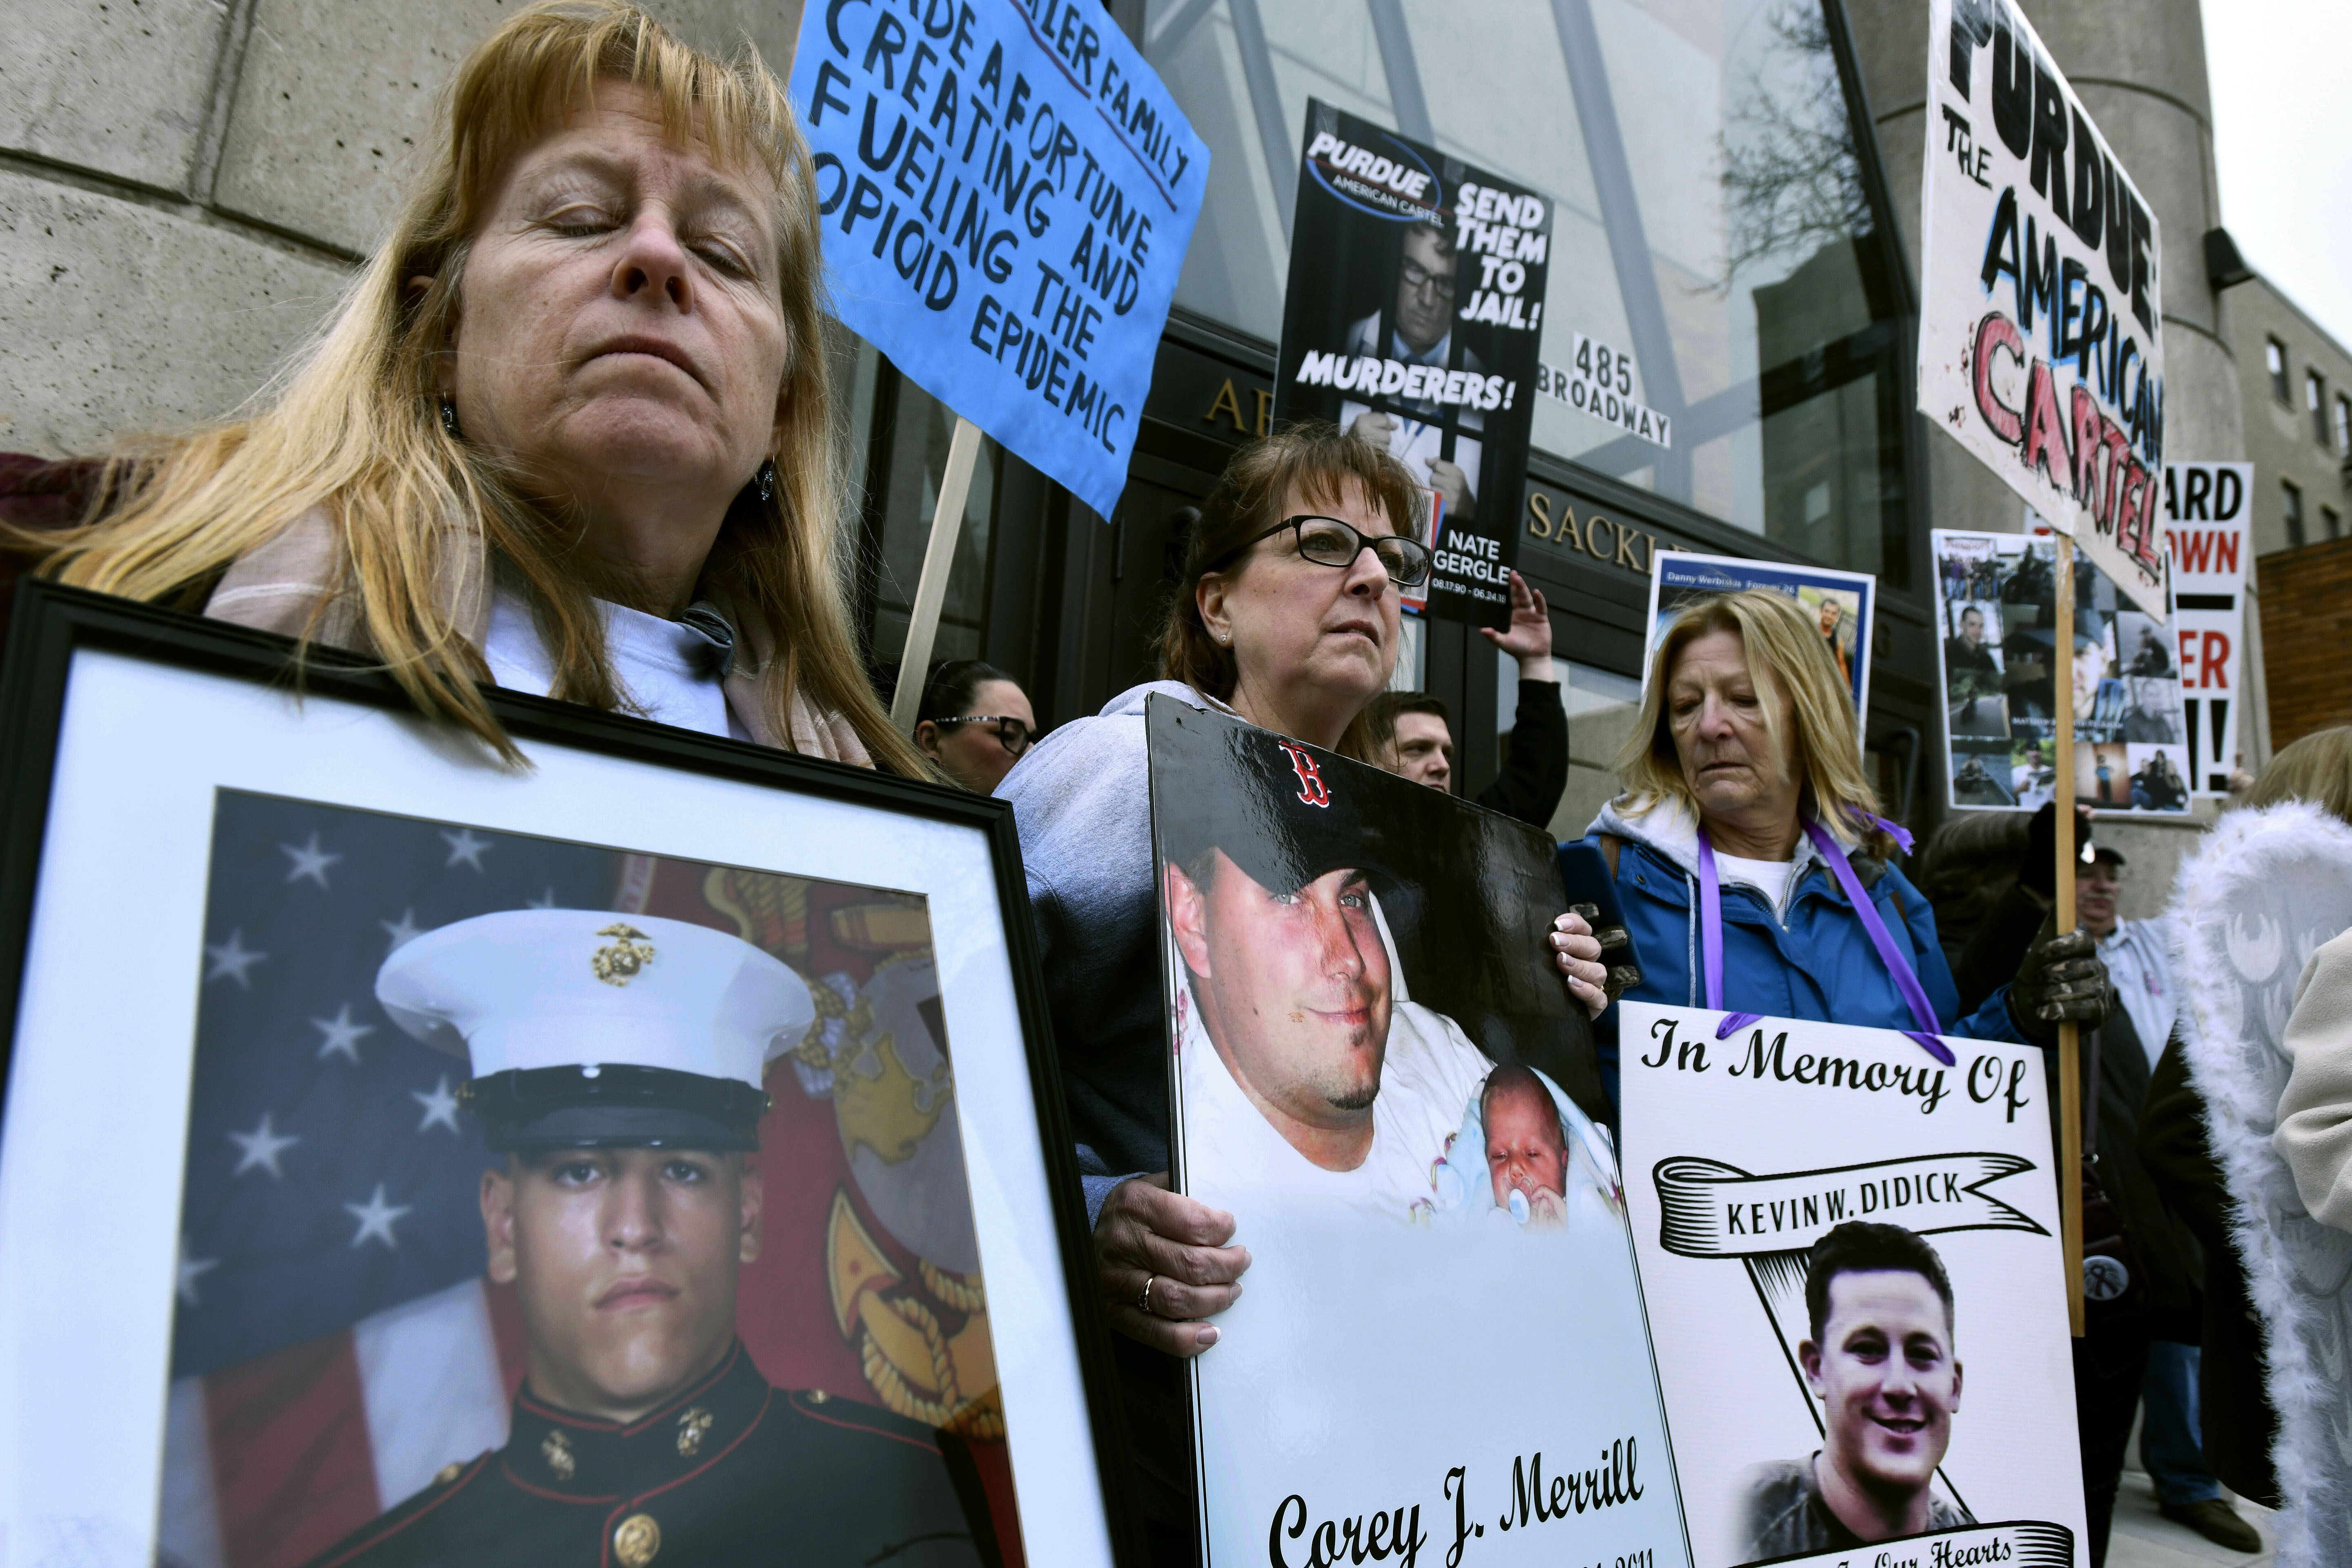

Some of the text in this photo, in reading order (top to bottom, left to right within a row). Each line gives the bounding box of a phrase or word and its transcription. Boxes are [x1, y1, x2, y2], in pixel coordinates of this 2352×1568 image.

[1026, 0, 1189, 189] LER FAMILY
[825, 0, 1139, 316] CREATING AND
[978, 38, 1003, 107] A
[1004, 72, 1152, 268] FORTUNE
[1307, 130, 1431, 200] PURDUE
[1941, 103, 1993, 190] THE
[808, 59, 1102, 361] FUELING THE
[1332, 174, 1444, 229] AMERICAN CARTEL
[1454, 182, 1545, 230] SEND
[1455, 215, 1548, 265] THEM
[813, 151, 1125, 454] OPIOID EPIDEMIC
[1480, 255, 1526, 294] TO
[1459, 289, 1542, 331] JAIL!
[1980, 185, 2163, 472] AMERICAN
[1295, 349, 1517, 412] MURDERERS!
[1576, 337, 1632, 398] 485
[1538, 362, 1668, 444] BROADWAY
[1972, 310, 2163, 586] CARTEL
[1432, 549, 1511, 586] GERGLE
[1448, 529, 1501, 561] NATE
[1431, 577, 1467, 595] 08.17.90
[1666, 571, 1695, 586] Danny
[1642, 1018, 2029, 1123] In Memory Of
[1727, 1171, 1963, 1235] KEVIN W. DIDICK
[1268, 1435, 1644, 1568] Corey J. Merrill
[1930, 1537, 2011, 1568] Hearts
